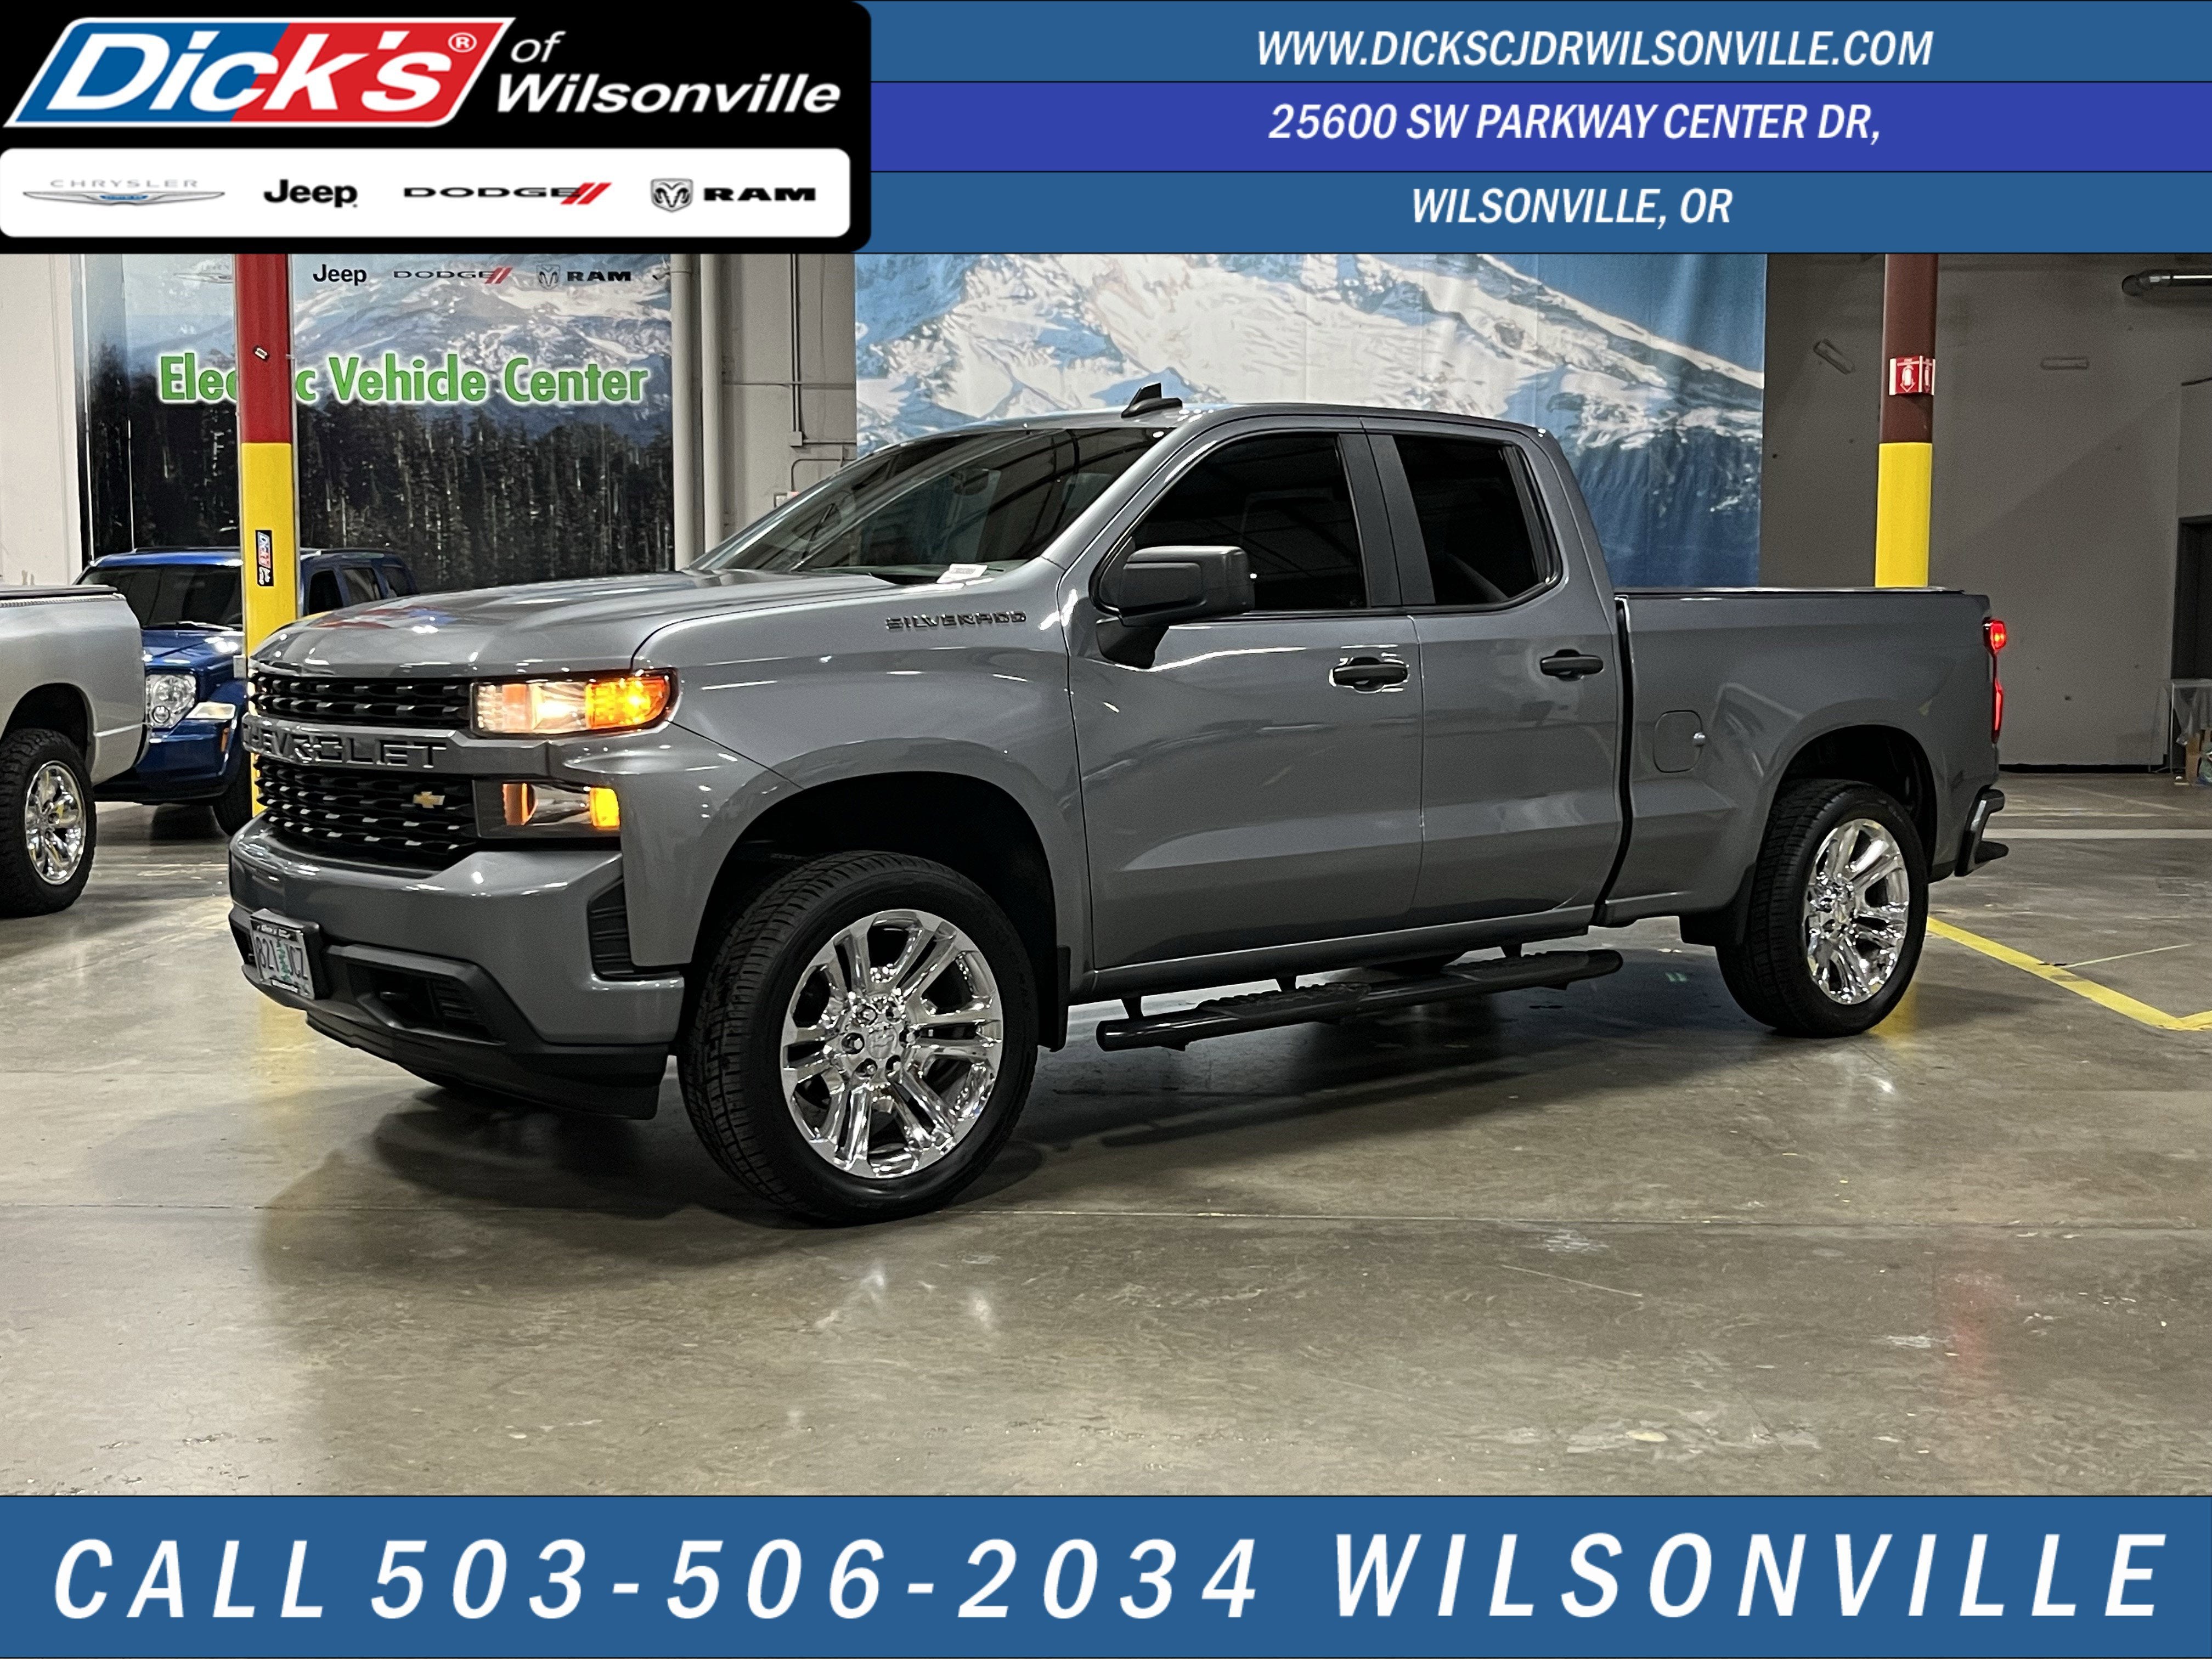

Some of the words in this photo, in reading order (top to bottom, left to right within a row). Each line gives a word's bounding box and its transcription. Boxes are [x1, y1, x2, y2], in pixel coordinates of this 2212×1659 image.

[313, 264, 367, 286] Jeep
[393, 270, 494, 279] DODGE
[567, 271, 631, 281] RAM
[329, 352, 486, 402] Vehicle
[504, 358, 648, 402] Center
[885, 610, 1026, 630] SILVERADO
